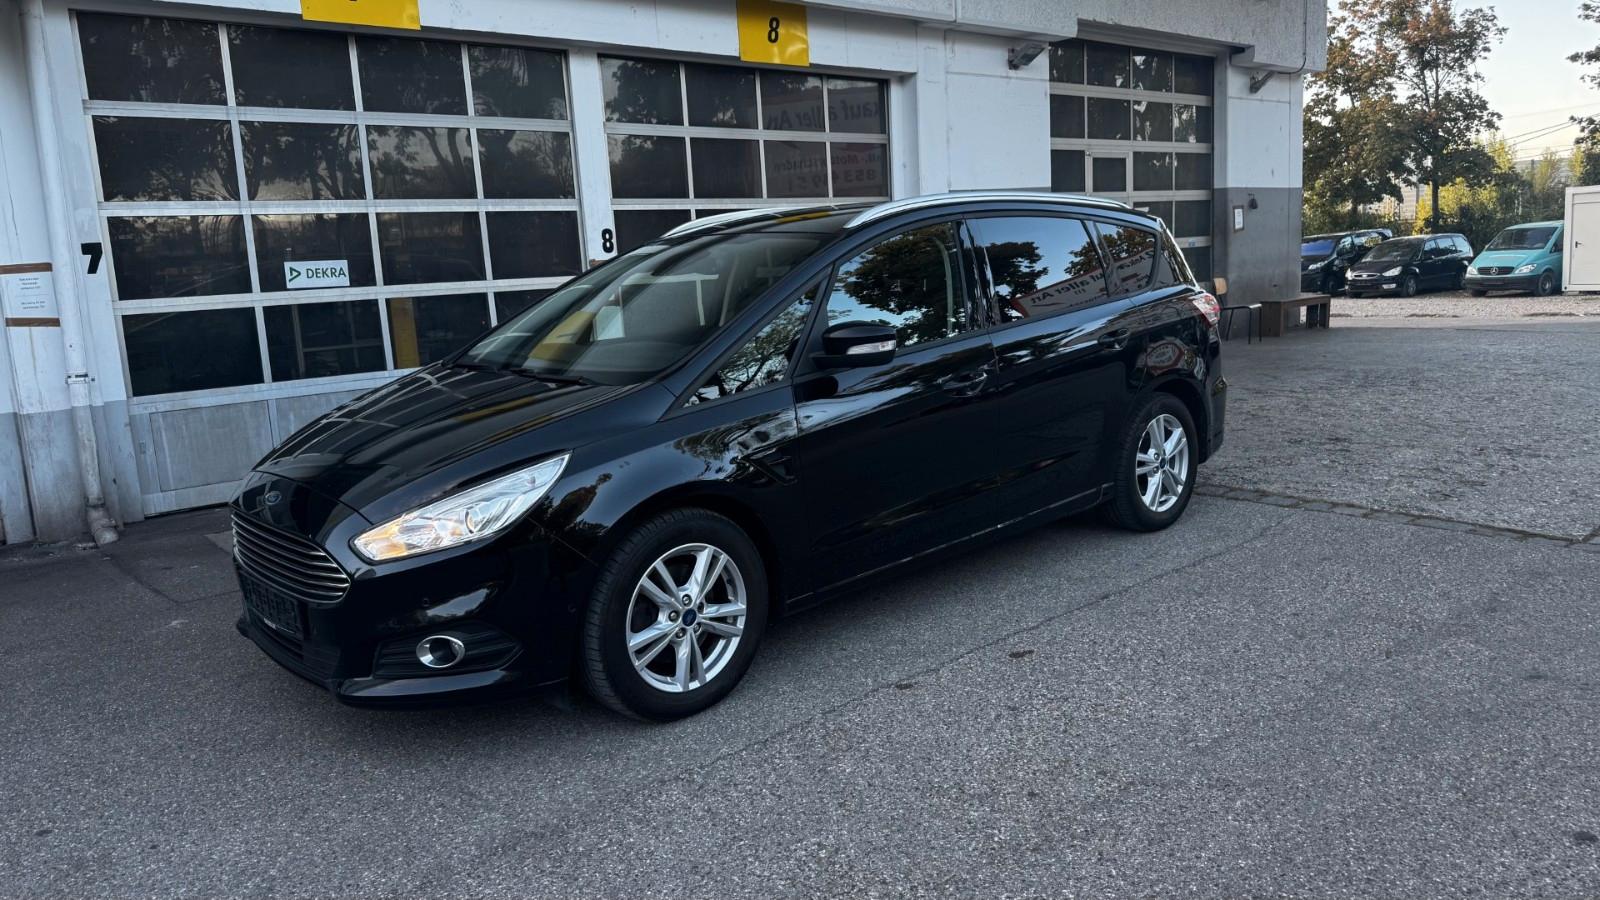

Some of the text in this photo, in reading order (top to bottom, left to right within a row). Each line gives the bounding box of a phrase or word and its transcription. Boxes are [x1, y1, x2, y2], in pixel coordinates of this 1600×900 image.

[767, 16, 780, 43] 8
[601, 228, 614, 253] 8
[80, 242, 103, 274] 7
[306, 267, 347, 279] DEKRA
